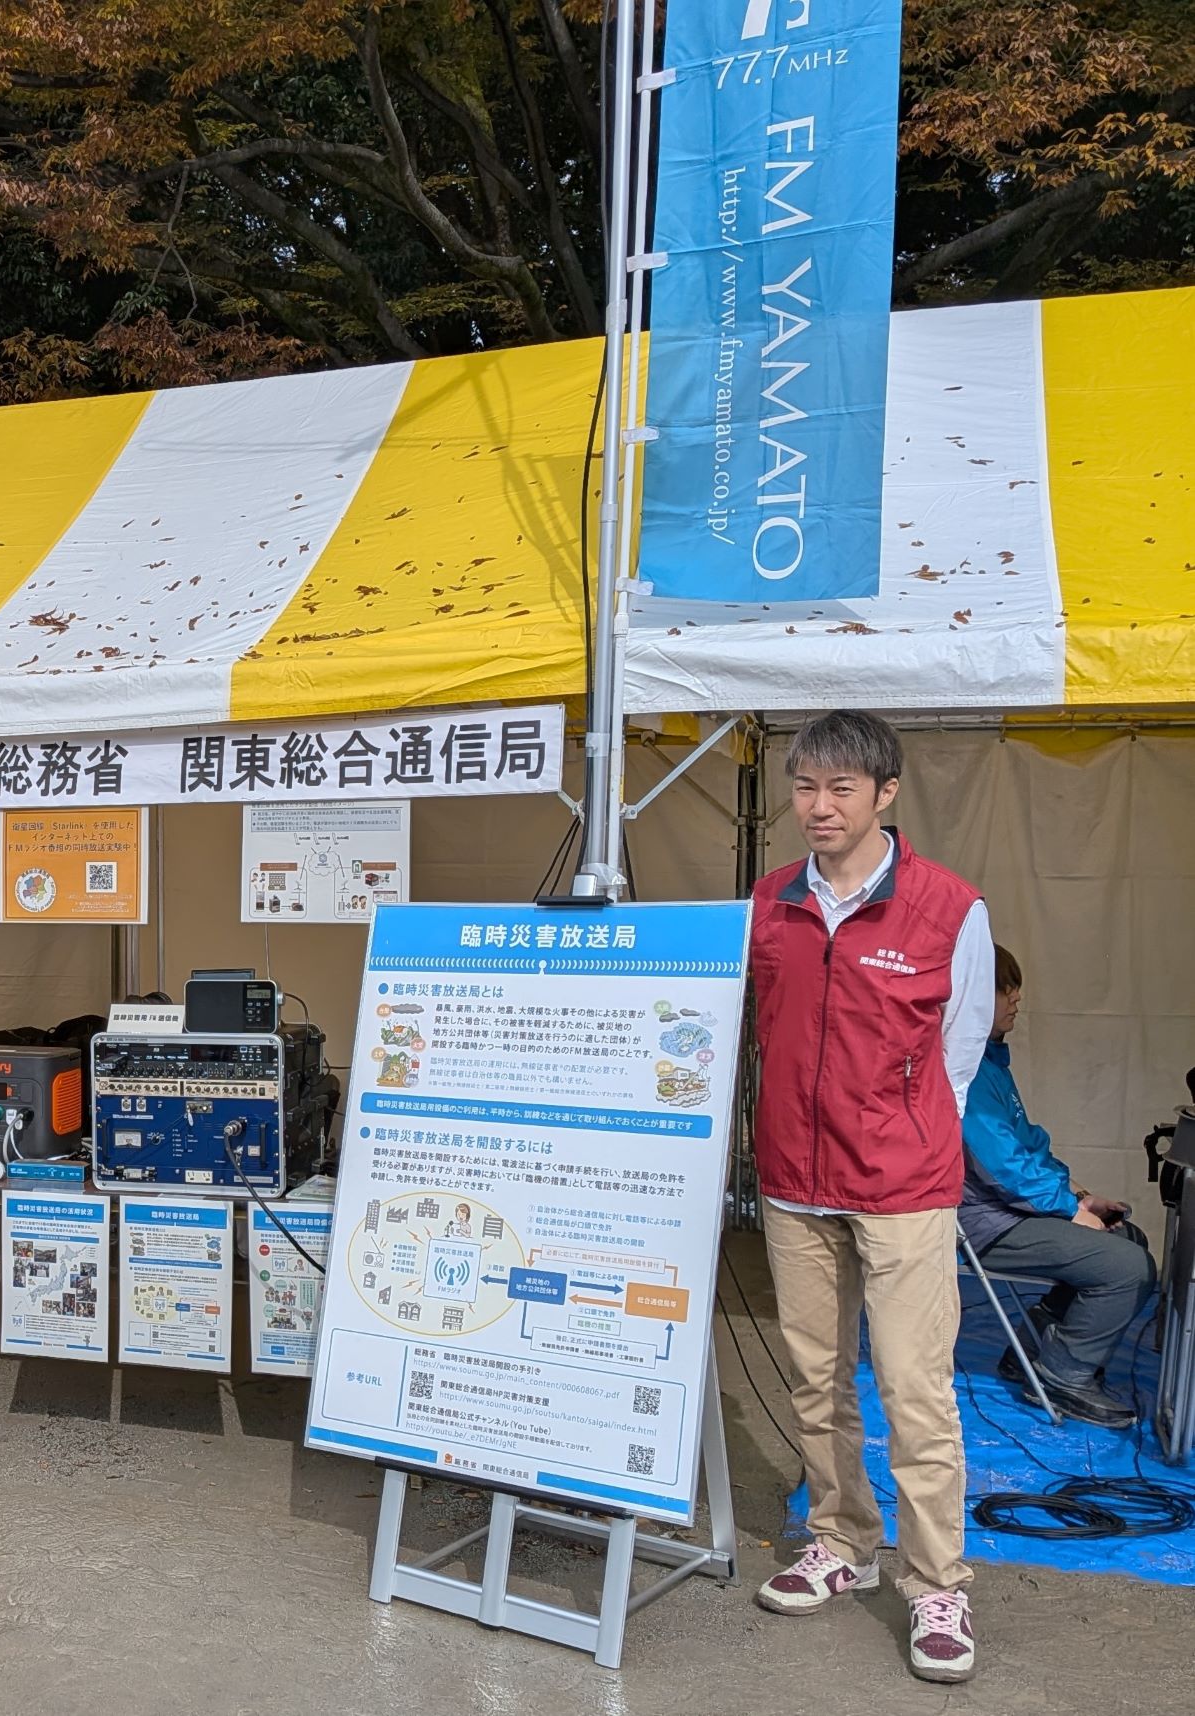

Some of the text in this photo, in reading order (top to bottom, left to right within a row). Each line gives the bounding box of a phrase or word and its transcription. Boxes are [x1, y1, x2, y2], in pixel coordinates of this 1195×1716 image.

[752, 114, 815, 580] FM YAMATO
[180, 719, 547, 793] 関東総合通信局
[460, 923, 637, 949] 臨時災害放送局
[393, 983, 504, 998] 臨時災害放送局とは
[374, 1127, 553, 1154] 臨時災害放送局を開設するには
[346, 1371, 383, 1387] 参考URL
